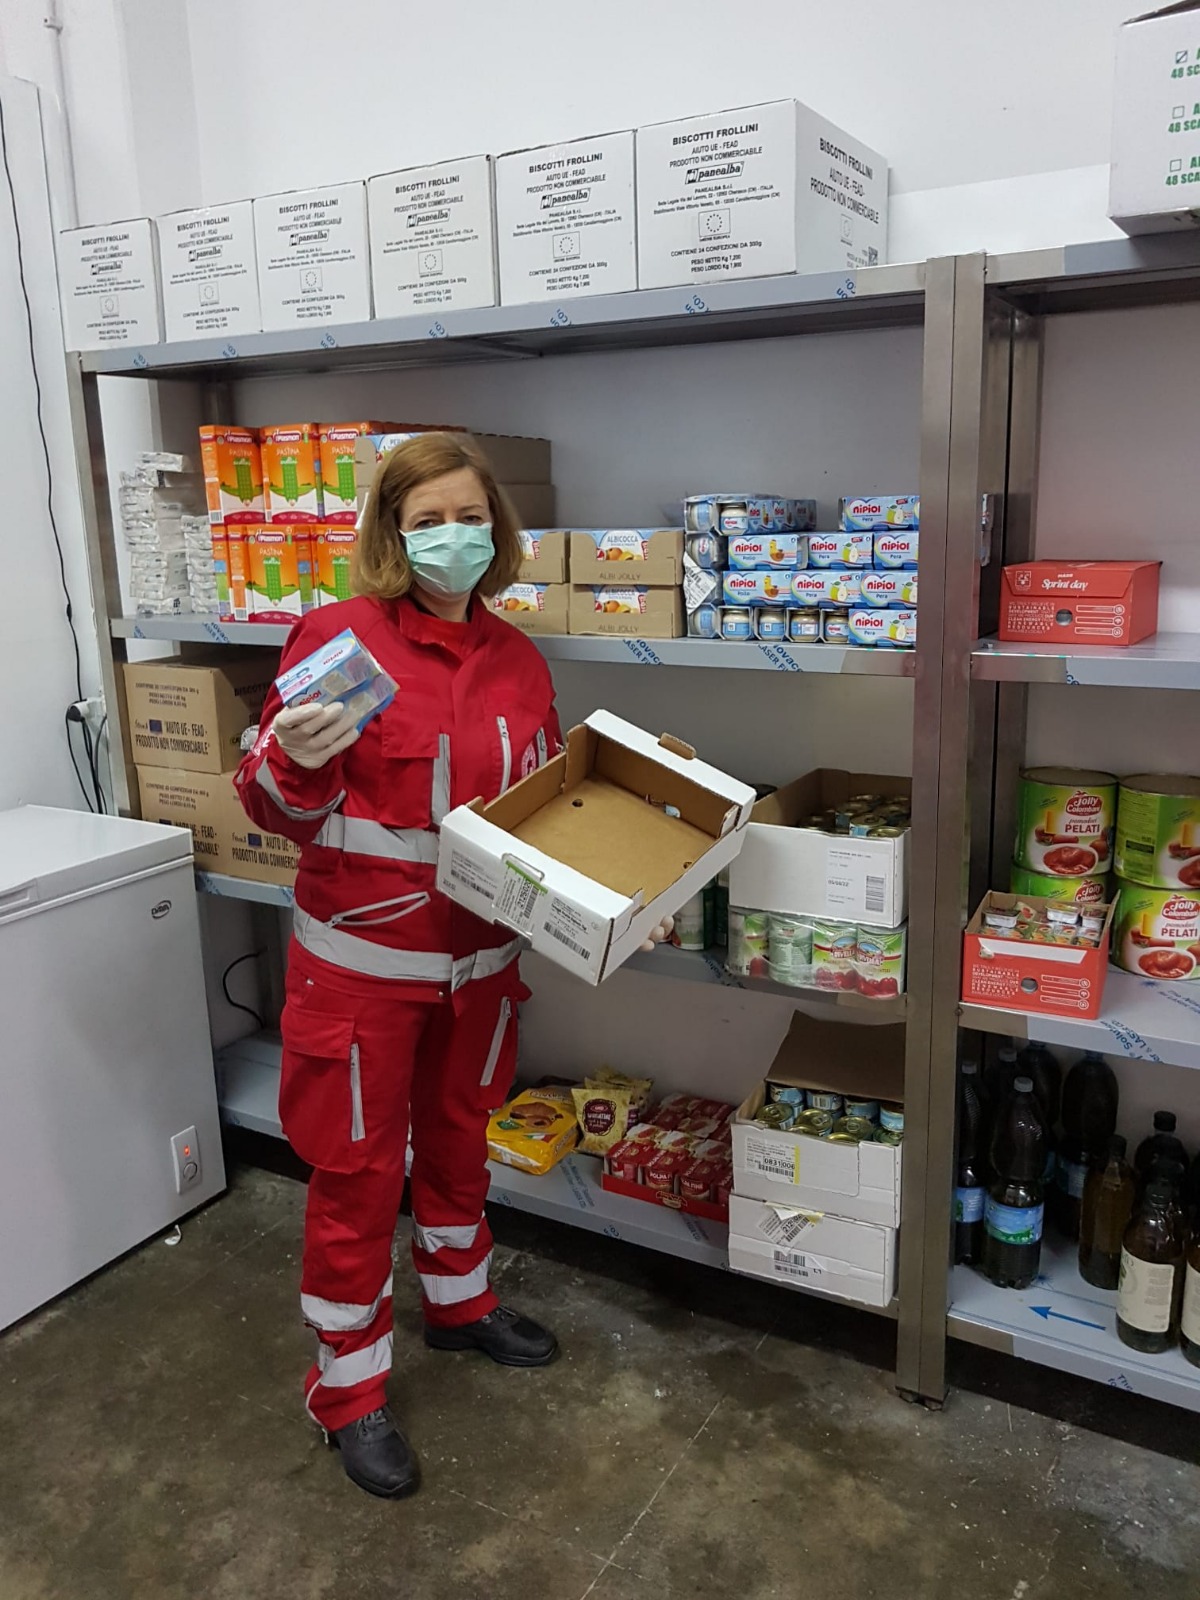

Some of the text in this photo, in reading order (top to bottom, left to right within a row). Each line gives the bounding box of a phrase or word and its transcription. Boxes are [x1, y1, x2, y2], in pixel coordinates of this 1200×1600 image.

[1171, 67, 1184, 79] 48
[672, 123, 759, 146] BISCOTTI FROLLINI
[1168, 122, 1181, 133] 48
[691, 140, 739, 155] AIUTO UE FEAD
[529, 152, 603, 173] BISCOTTI FROLLINI
[669, 146, 763, 168] PRODOTTO NON COMMERCIABILE
[819, 137, 873, 180] BISCOTTI FROLLINI
[546, 168, 586, 182] AIUTO UE FEAD
[697, 164, 741, 182] panealba
[395, 175, 460, 194] BISCOTTI FROLLINI
[526, 174, 606, 194] PRODOTTO NON COMMERCIABILE
[1165, 175, 1178, 186] 48
[279, 198, 339, 214] BISCOTTI FROLLINI
[177, 216, 230, 232] BISCOTTI FROLLINI
[670, 248, 697, 257] CONTIENE
[705, 243, 739, 253] CONFEZIONI
[705, 256, 721, 264] NETTO
[607, 535, 639, 543] ALBICOCCA
[1041, 579, 1089, 591] Sprint day
[180, 722, 188, 736] UE
[191, 723, 205, 737] FEAD
[135, 734, 160, 749] PRODOTTO
[160, 737, 170, 750] NON
[1073, 796, 1099, 807] Jolly
[201, 825, 214, 839] FEAD
[1064, 824, 1100, 833] PELATI
[231, 848, 257, 864] PRODOTTO
[258, 851, 269, 866] NON
[1170, 900, 1197, 911] Jolly
[1161, 927, 1198, 938] PELATI
